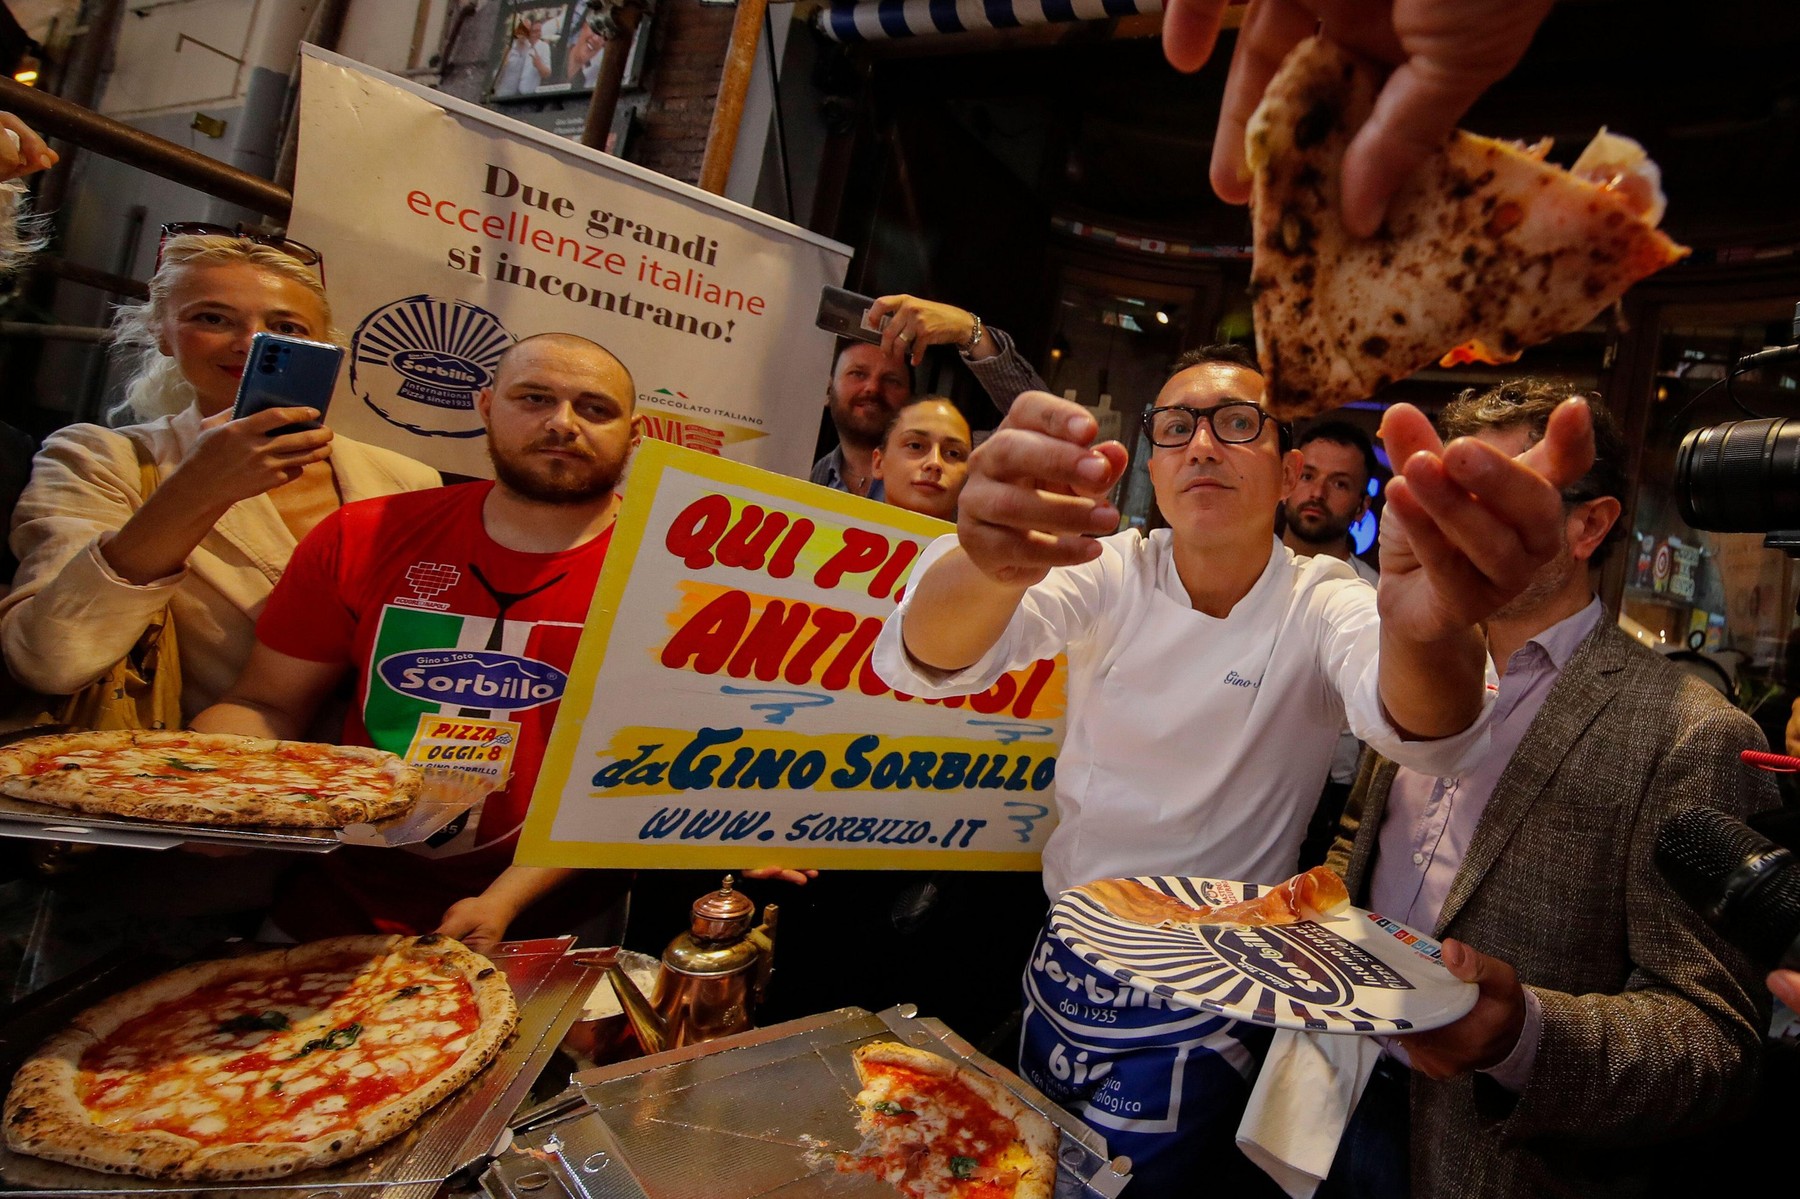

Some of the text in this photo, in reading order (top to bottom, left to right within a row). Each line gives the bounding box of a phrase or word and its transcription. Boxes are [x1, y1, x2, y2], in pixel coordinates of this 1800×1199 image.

[481, 163, 719, 267] Due grandi
[406, 190, 765, 316] eccellenze italiane
[448, 245, 736, 343] si incontrano!
[402, 360, 477, 382] Sorbillo
[401, 388, 425, 400] Pizza
[405, 382, 470, 400] International
[638, 394, 763, 425] CIOCCOLATO ITALIANO
[665, 494, 919, 604] QUI PI
[416, 655, 441, 664] Gino
[451, 653, 474, 661] Toto
[400, 668, 554, 699] Sorbillo
[1223, 670, 1251, 688] Gino
[431, 723, 497, 742] PIZZA
[427, 746, 477, 760] OGGI
[488, 745, 502, 761] 8
[592, 744, 668, 788] da
[831, 735, 1056, 791] SORBILLO
[1286, 926, 1381, 986] International
[1371, 964, 1408, 989] Pizza
[1059, 998, 1118, 1024] dal 1935
